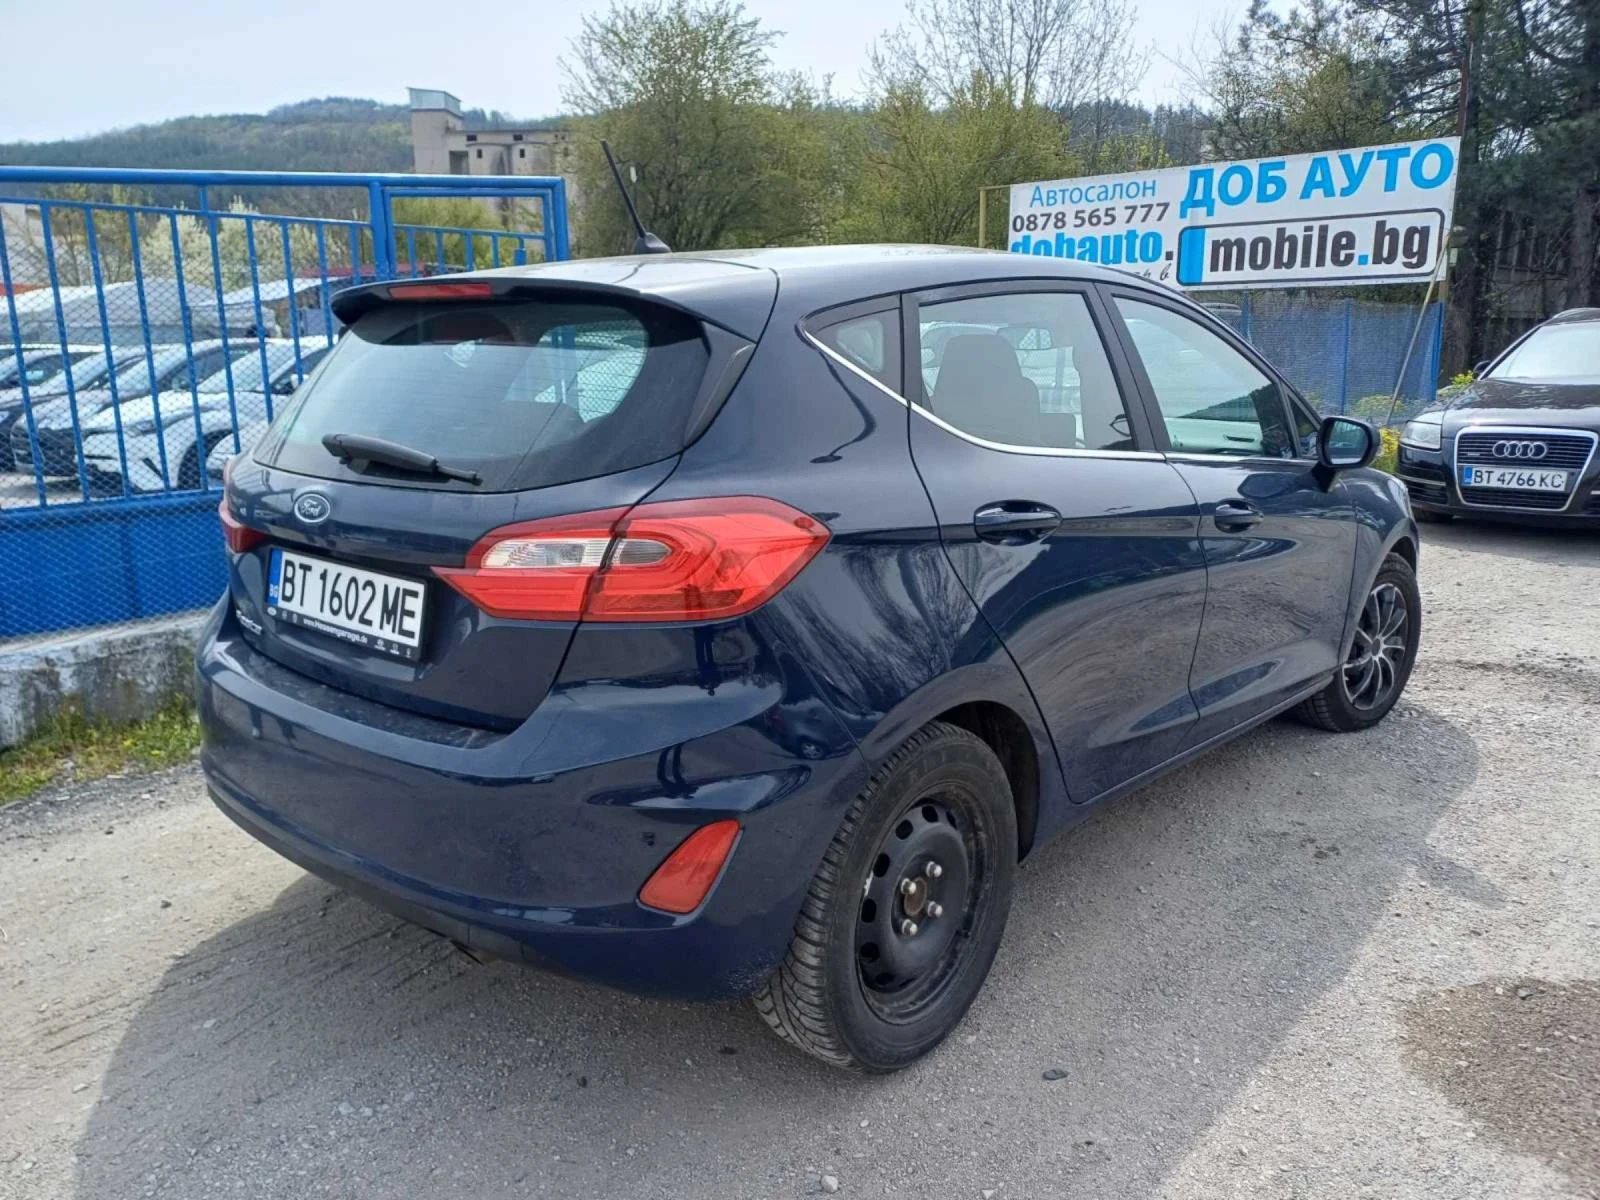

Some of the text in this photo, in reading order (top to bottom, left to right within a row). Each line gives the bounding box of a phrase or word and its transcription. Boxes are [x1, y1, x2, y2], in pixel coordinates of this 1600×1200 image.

[1029, 180, 1157, 208] Автосалон
[1180, 142, 1455, 218] ДОБ АУТО
[1012, 202, 1170, 232] 0878 565 777
[1209, 219, 1431, 272] mobile.bg
[1473, 469, 1494, 485] BT
[1497, 471, 1536, 487] 4766
[281, 559, 312, 606] BT
[319, 568, 377, 627] 1602
[379, 583, 420, 639] ME
